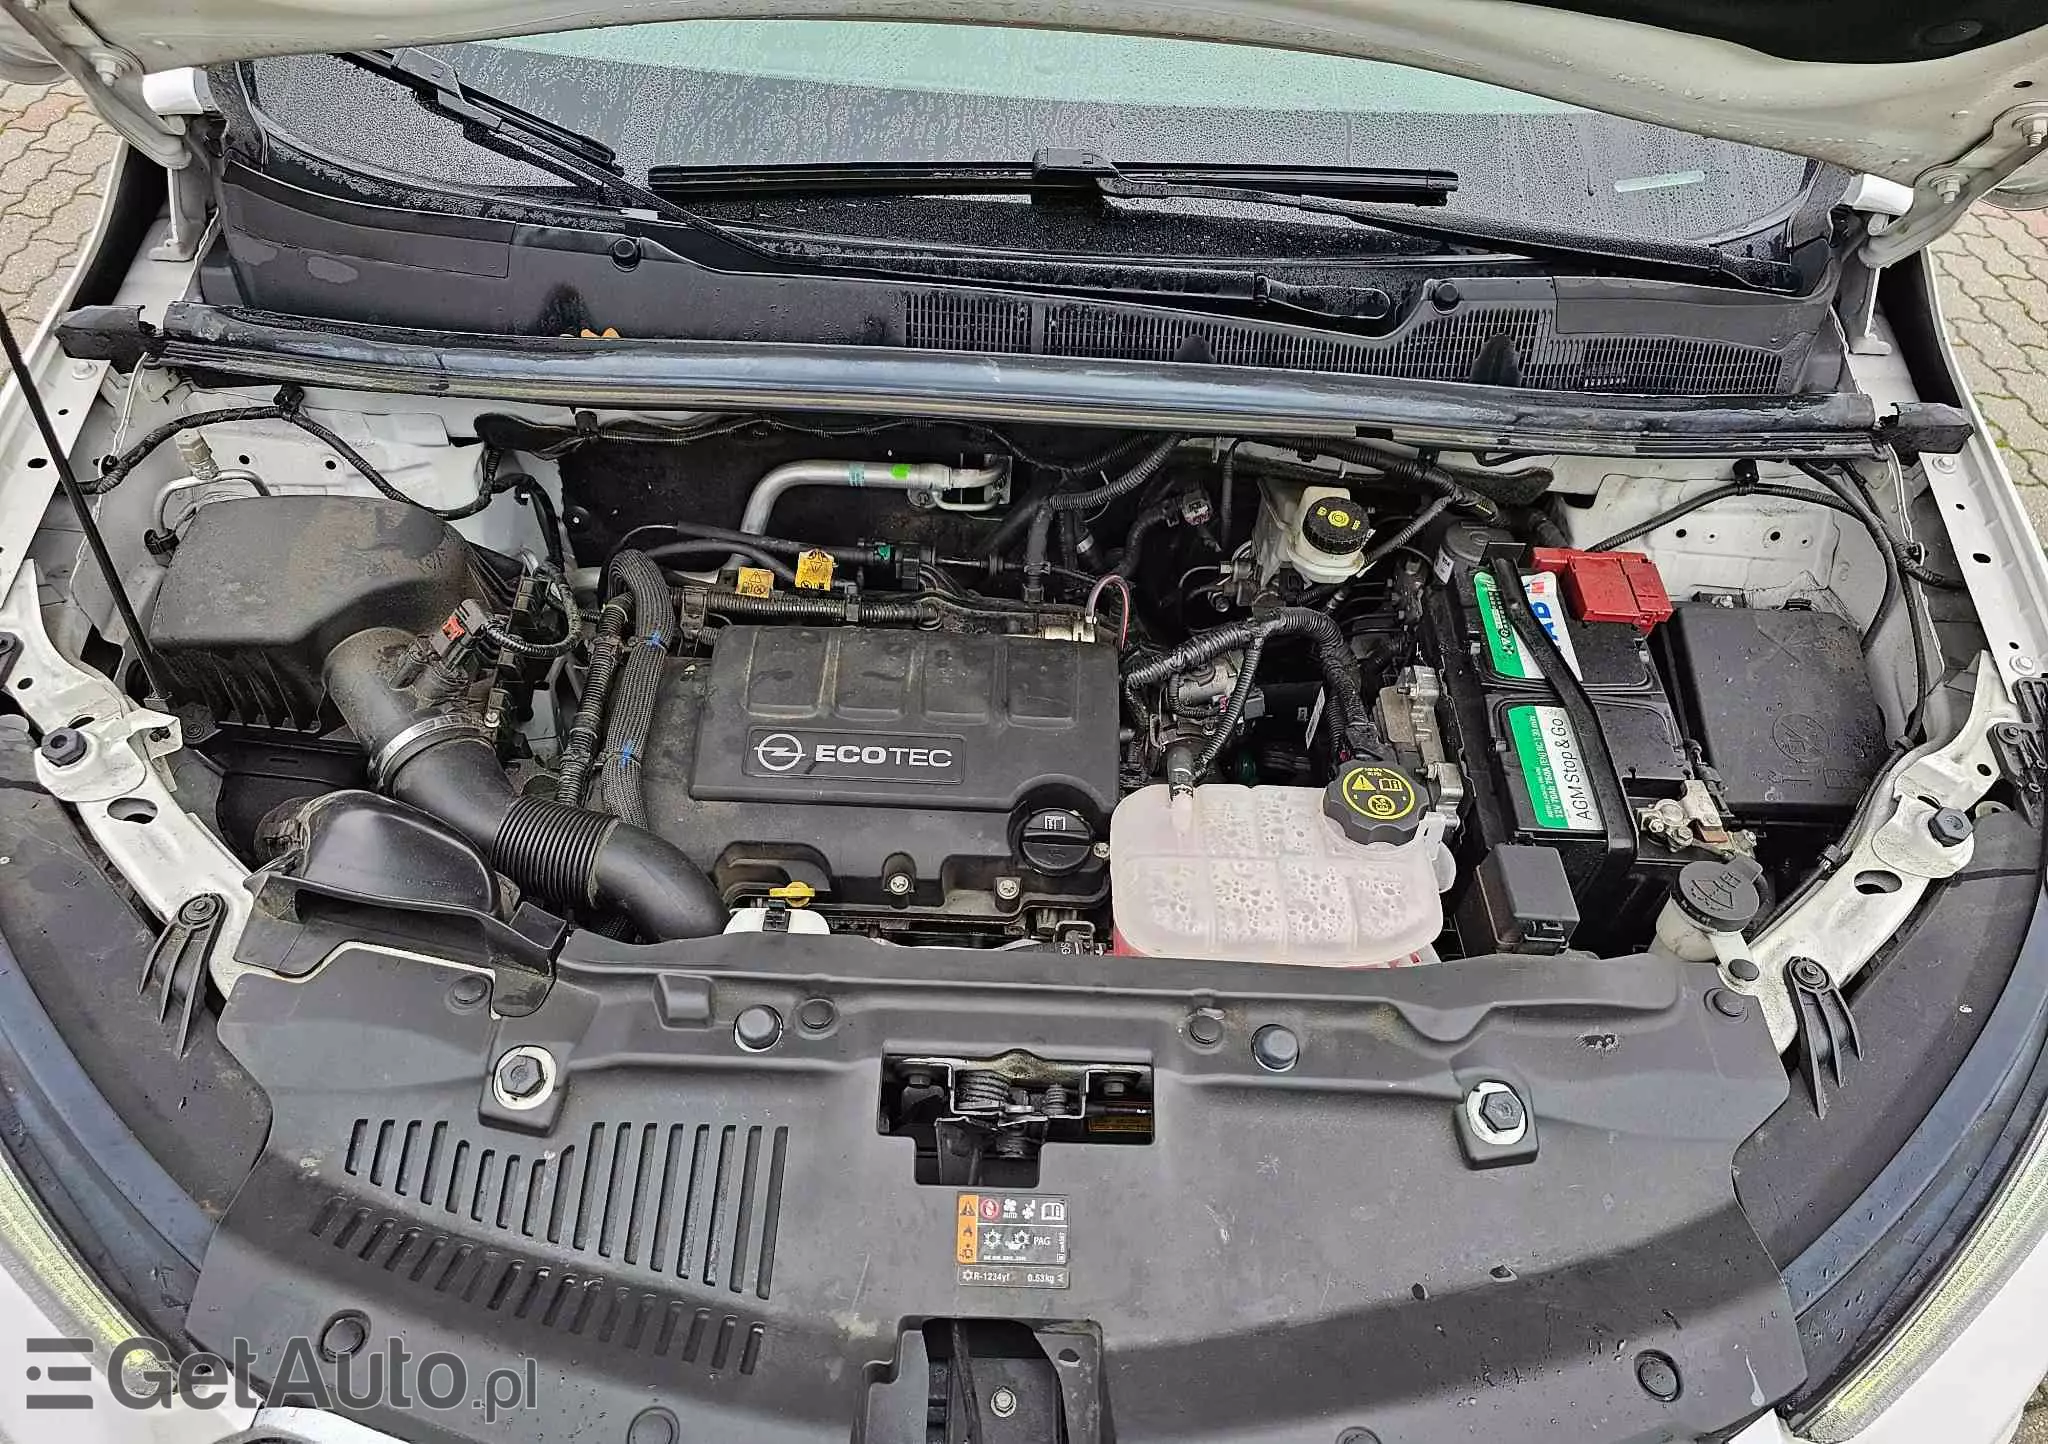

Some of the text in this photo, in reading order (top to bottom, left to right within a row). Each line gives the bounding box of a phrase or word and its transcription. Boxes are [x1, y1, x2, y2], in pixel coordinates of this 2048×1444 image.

[815, 744, 953, 768] ECOTEC
[1550, 718, 1593, 820] AGM Stop & Go
[1033, 1236, 1051, 1246] PAG
